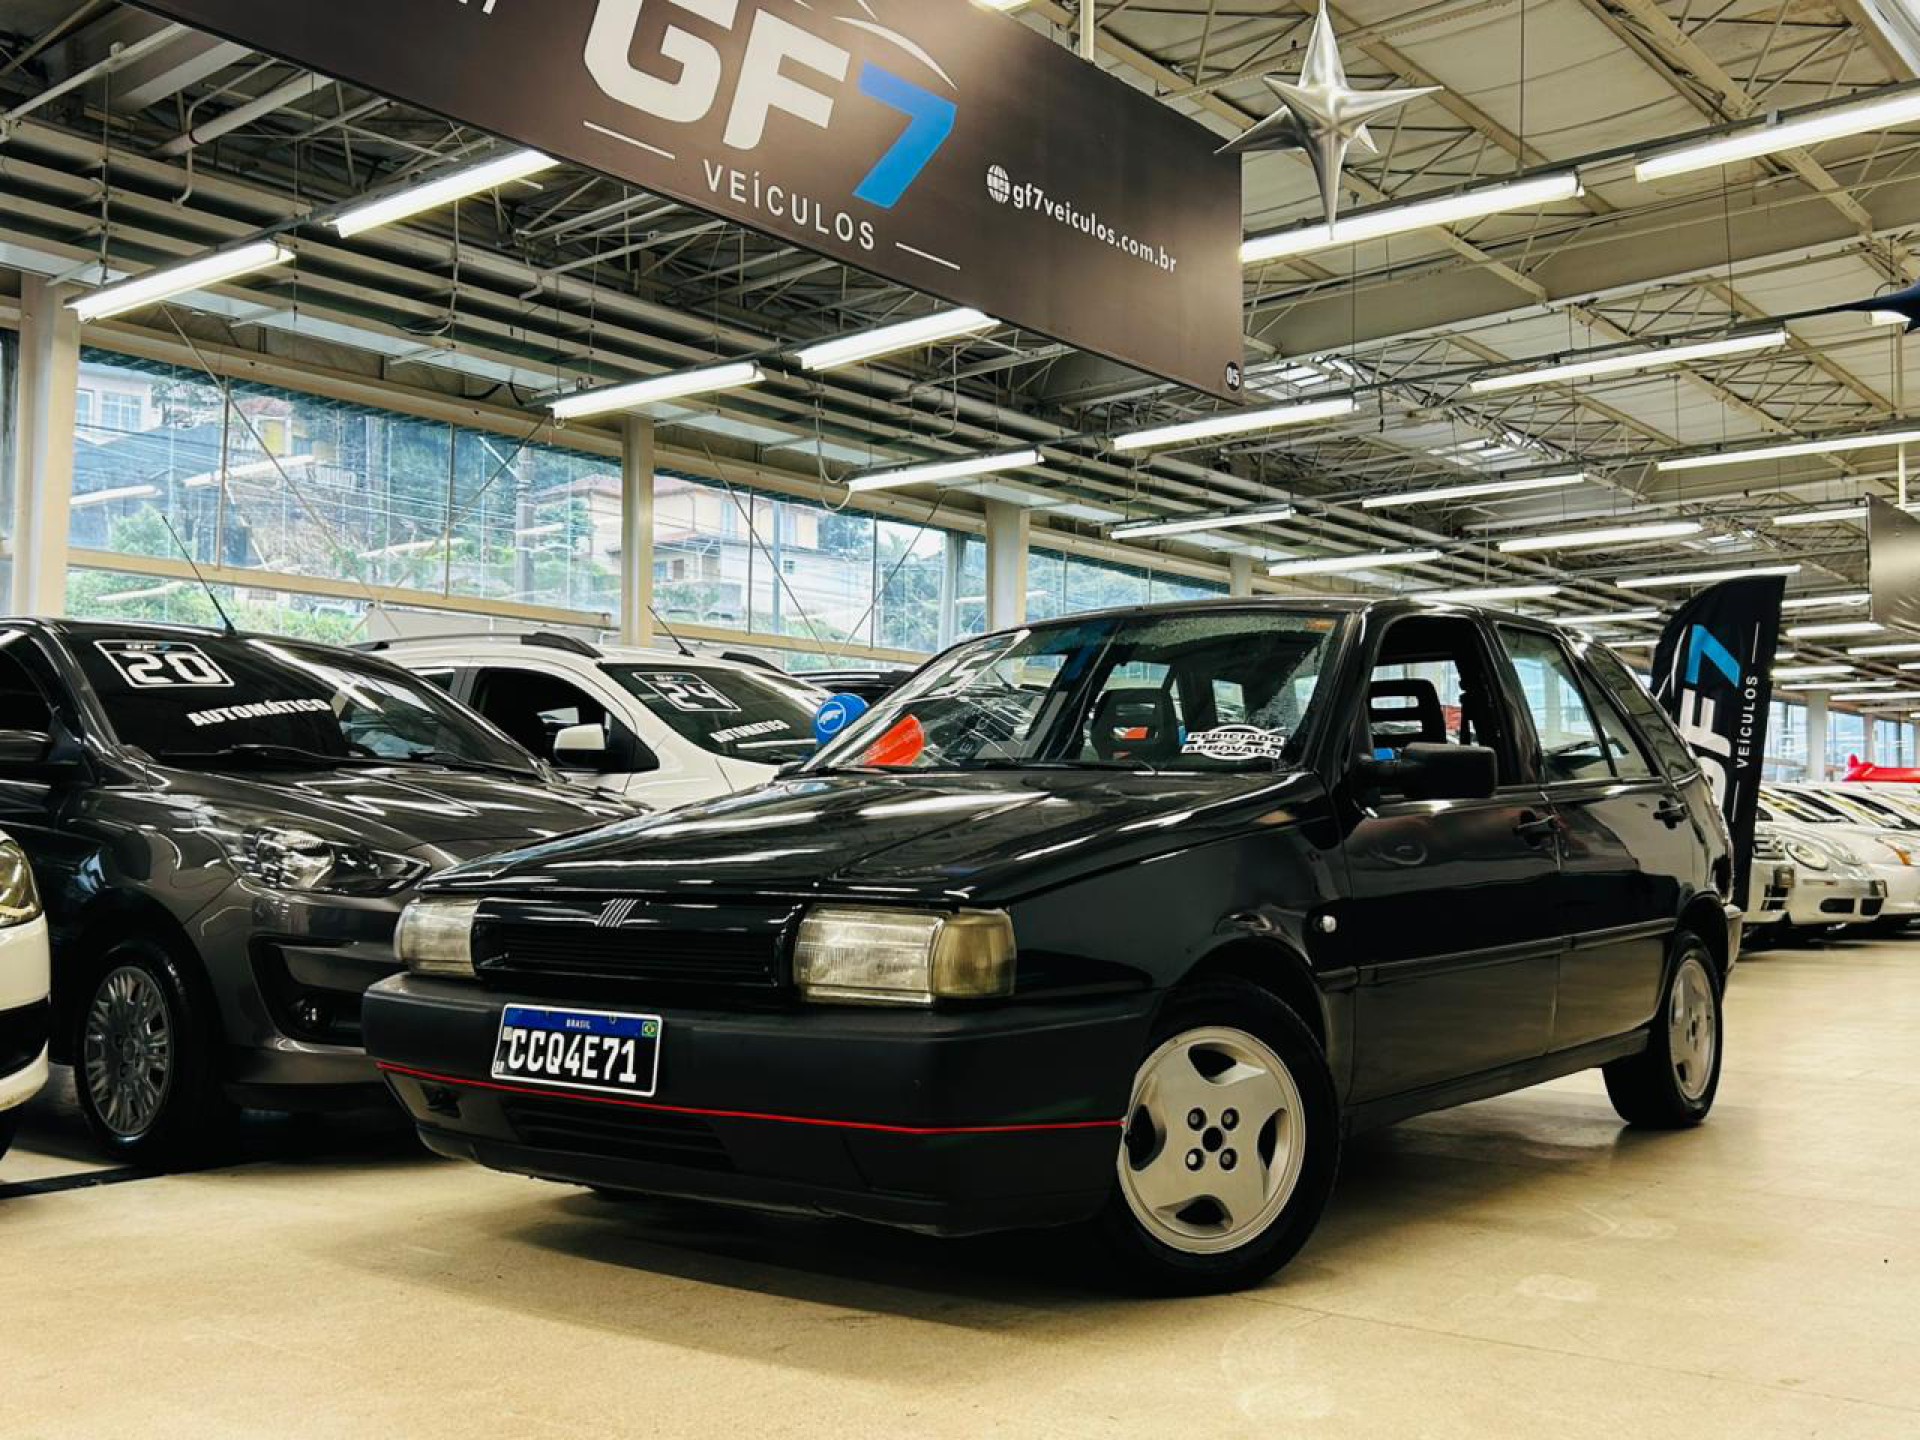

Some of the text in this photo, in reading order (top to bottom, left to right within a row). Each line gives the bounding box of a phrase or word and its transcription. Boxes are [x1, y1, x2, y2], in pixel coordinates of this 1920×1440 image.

[584, 0, 957, 209] GF7
[704, 159, 875, 250] VEÍCULOS
[1013, 183, 1177, 272] gf7veiculos.com.br
[120, 651, 224, 684] 20
[186, 699, 333, 726] AUTOMÁTICO
[655, 683, 735, 709] 24
[1190, 732, 1282, 743] PERICIADO
[1737, 675, 1758, 769] VEÍCULOS
[1186, 745, 1279, 757] APROVADO
[566, 1018, 591, 1029] BRASIL
[508, 1029, 637, 1083] CCQ4E71
